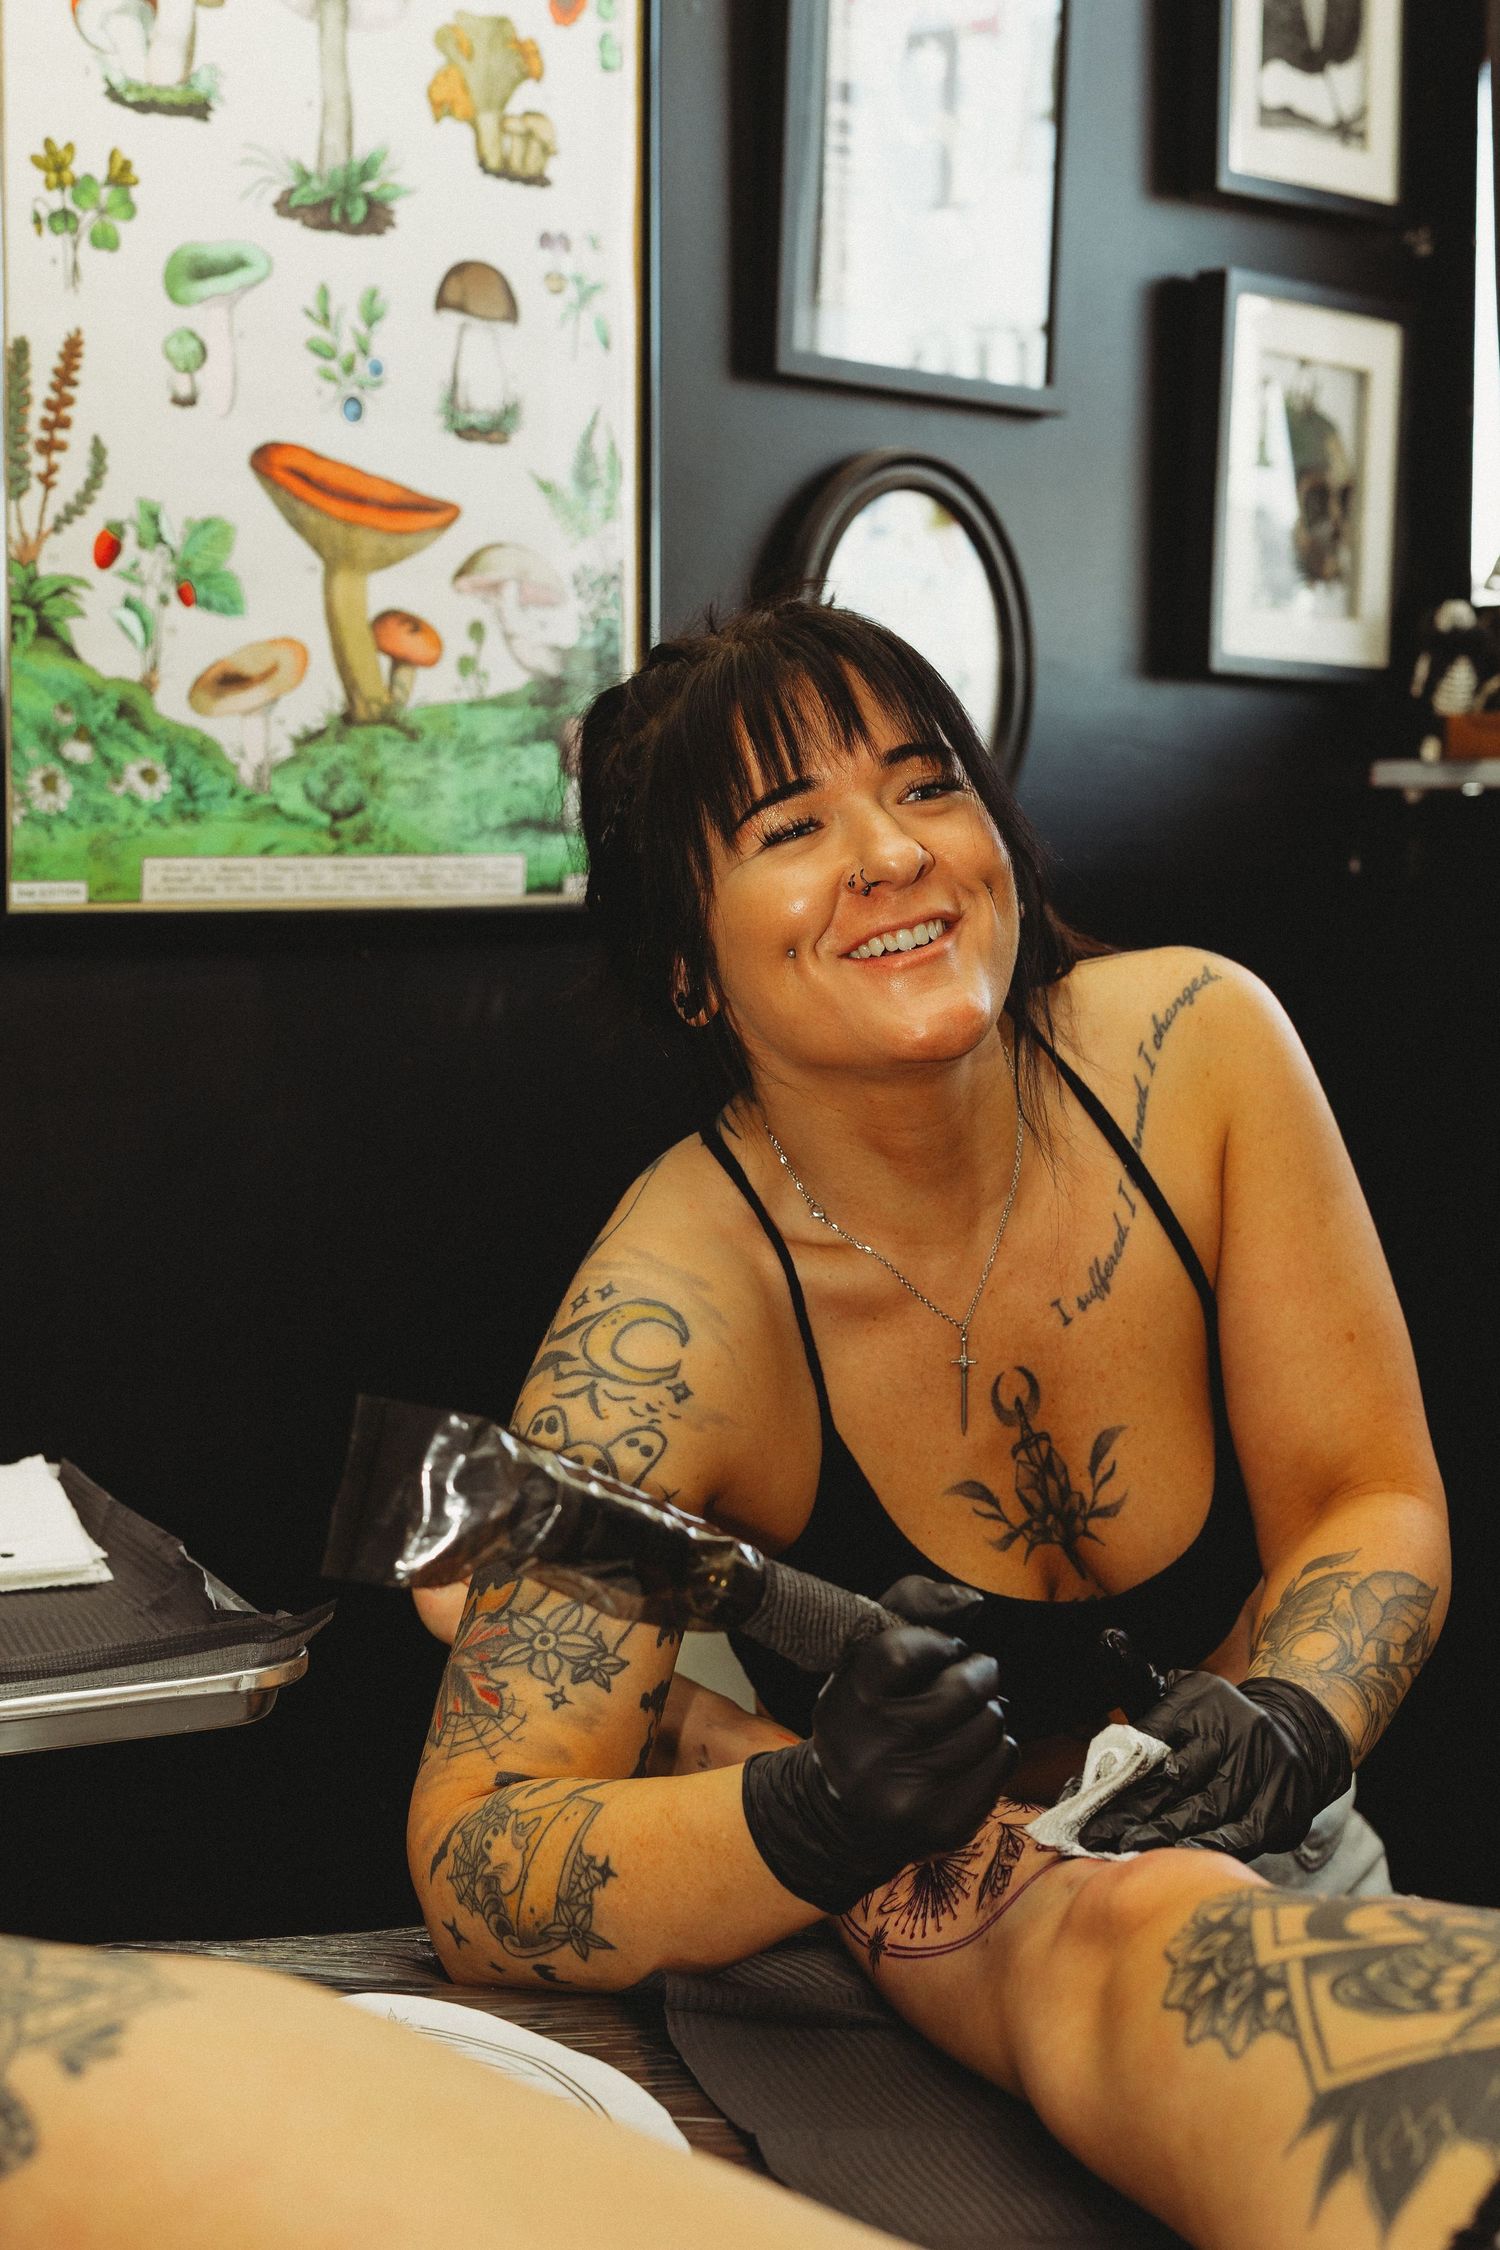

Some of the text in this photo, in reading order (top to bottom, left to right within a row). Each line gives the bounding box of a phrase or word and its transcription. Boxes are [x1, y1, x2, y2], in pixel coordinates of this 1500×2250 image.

[1050, 1297, 1073, 1328] I
[1118, 1178, 1136, 1219] I
[1138, 1041, 1156, 1077] I
